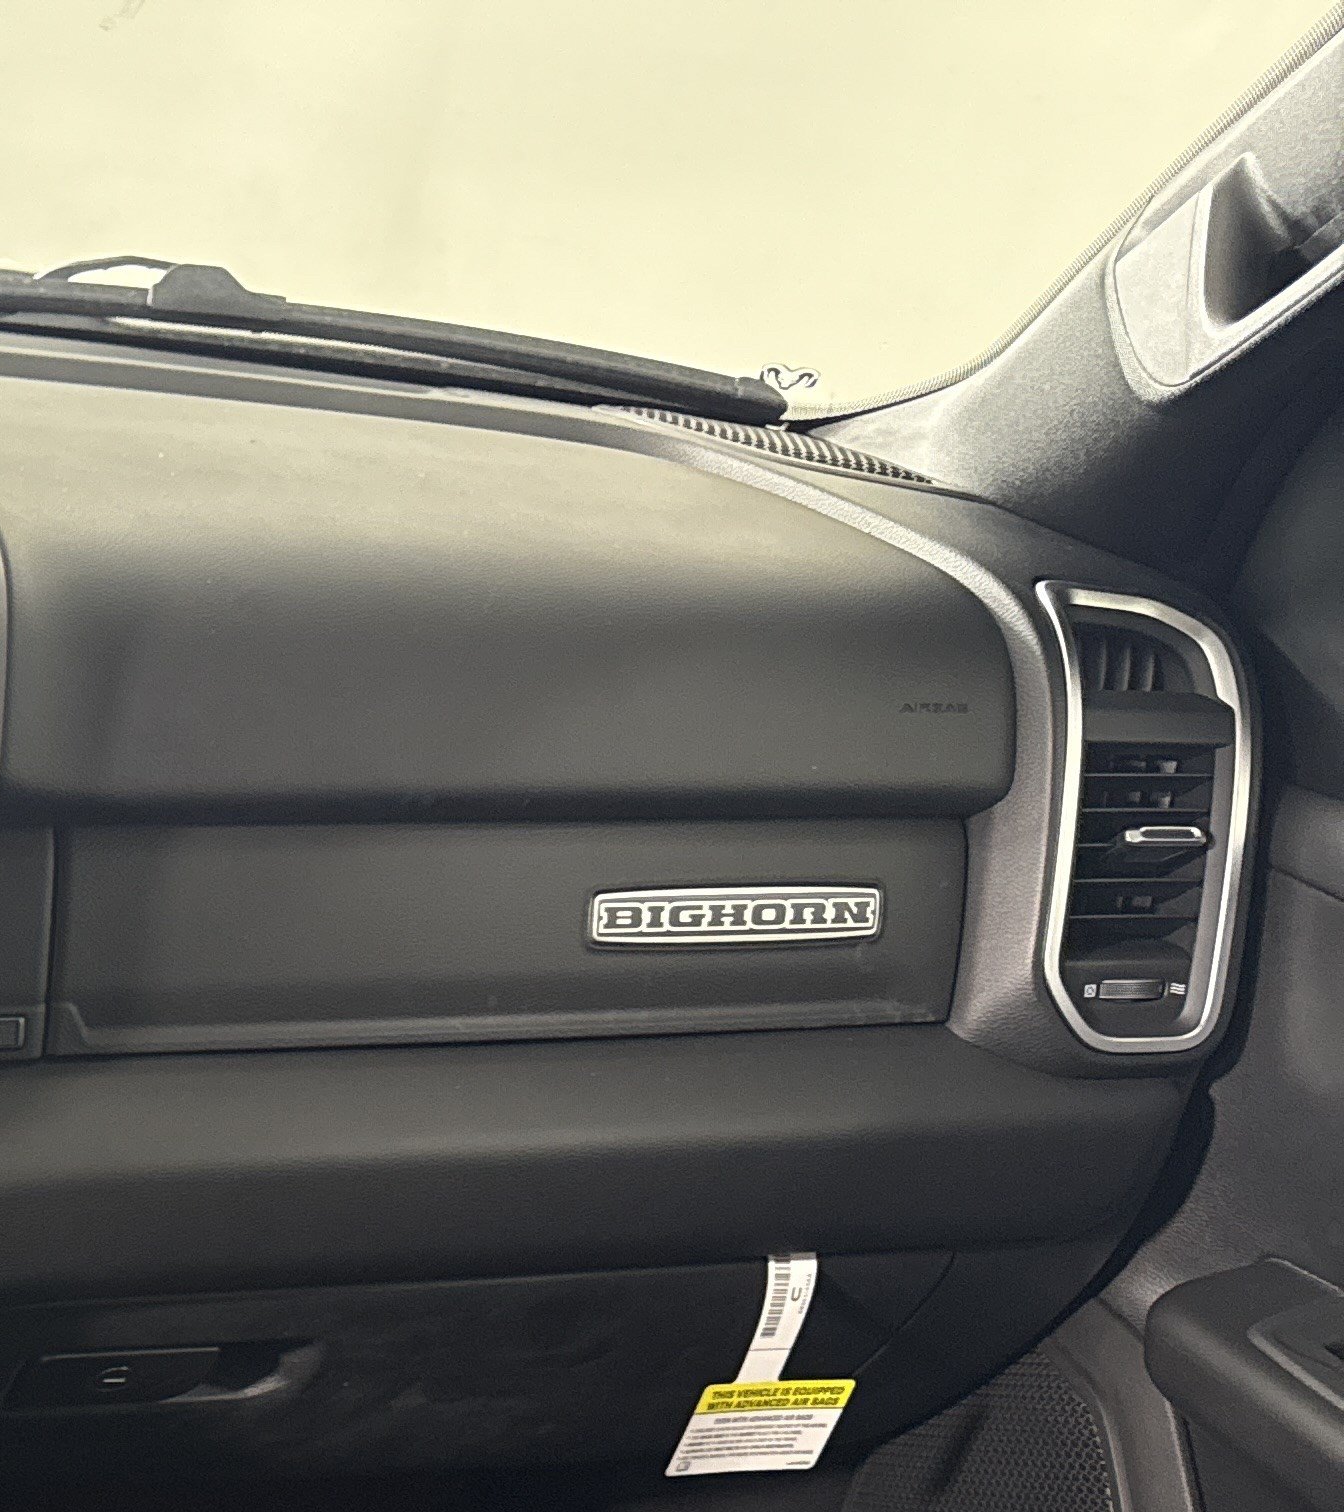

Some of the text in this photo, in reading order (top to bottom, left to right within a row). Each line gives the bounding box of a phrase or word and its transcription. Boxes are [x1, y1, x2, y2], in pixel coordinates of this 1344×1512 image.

[598, 898, 875, 934] BIGHORN
[711, 1386, 846, 1400] THIS VEHICLE IS EQUIPPED
[706, 1396, 841, 1411] WITH ADVANCED AIR BAGS
